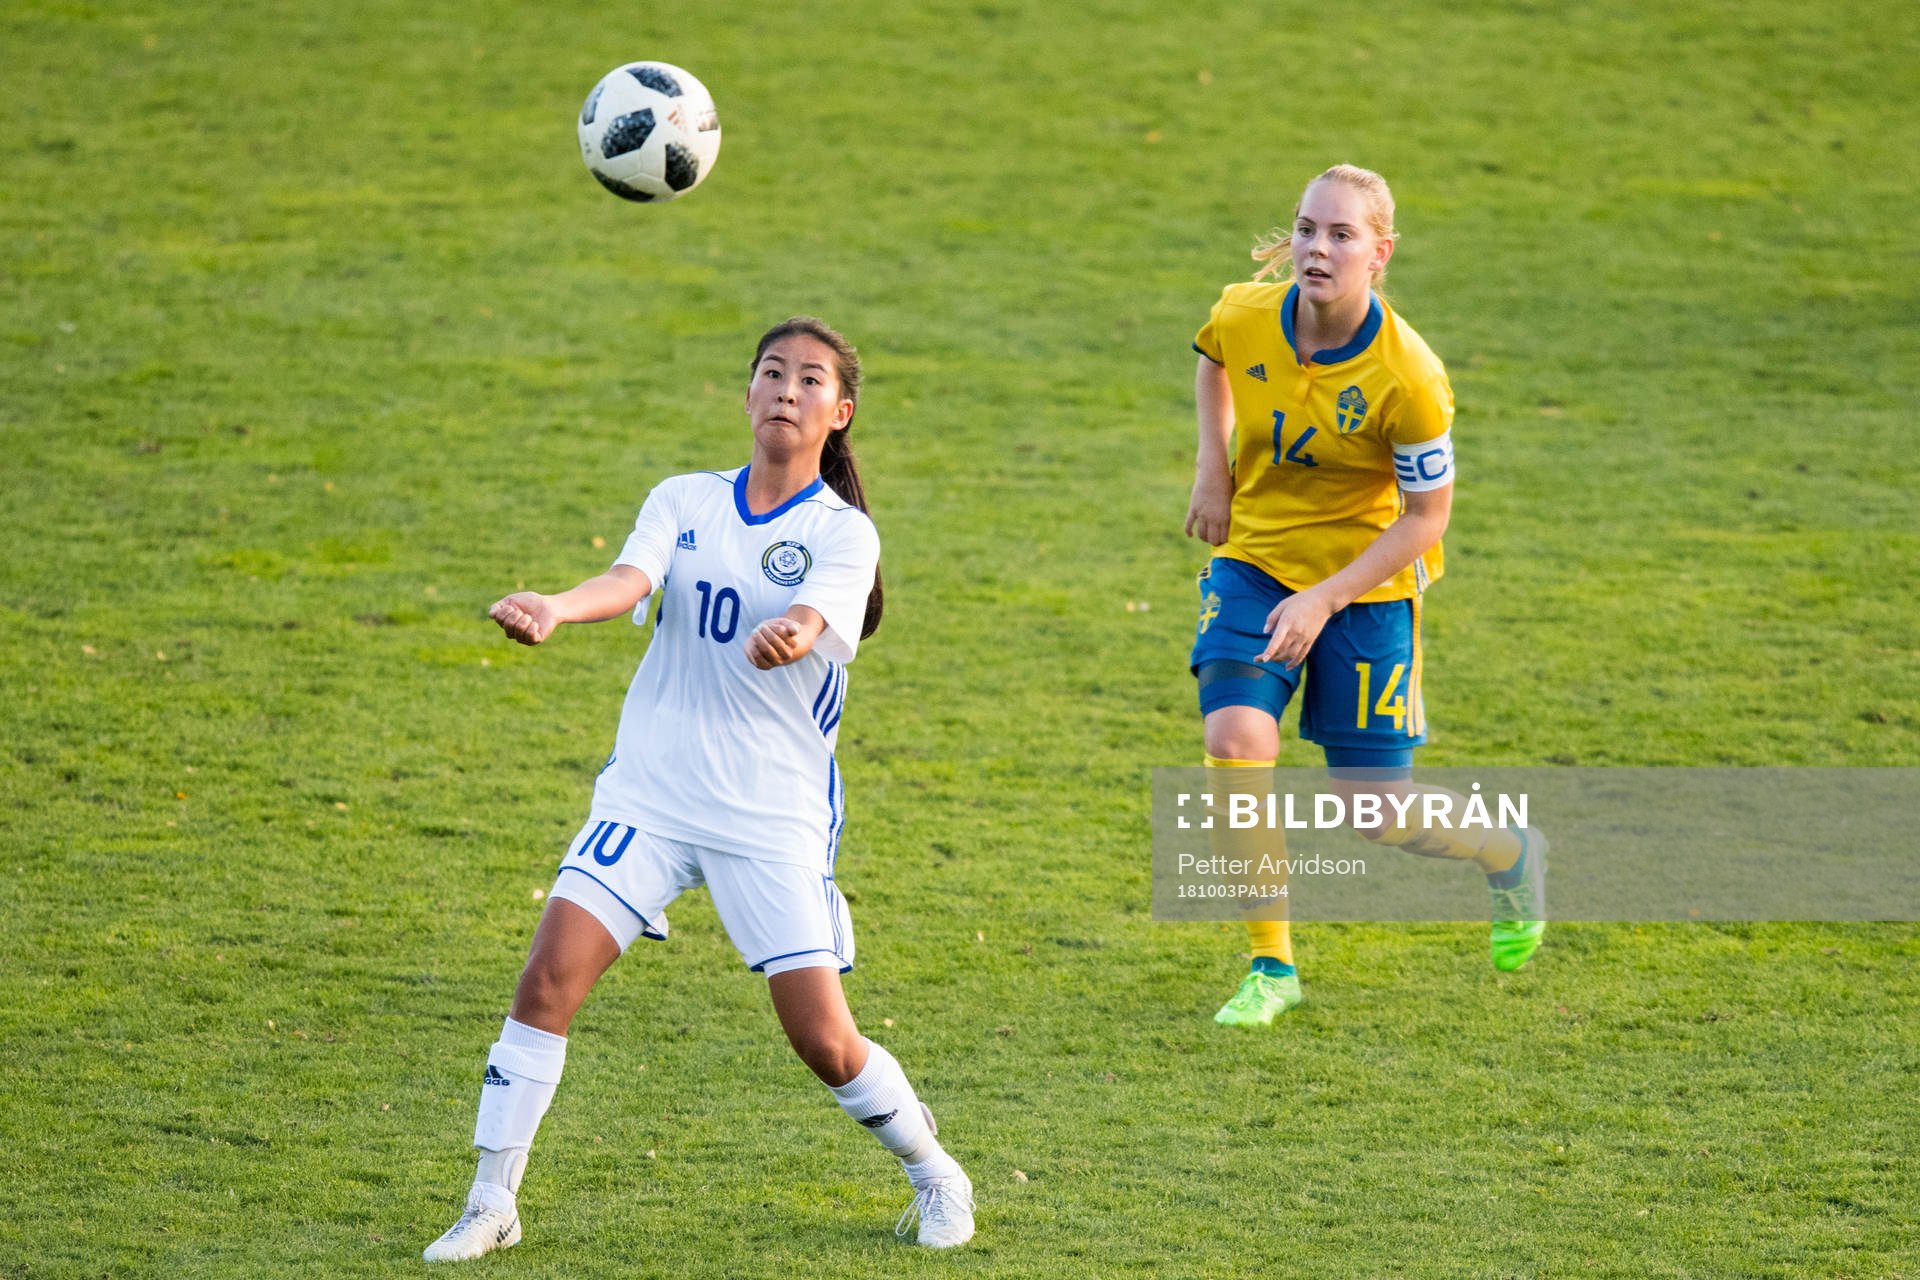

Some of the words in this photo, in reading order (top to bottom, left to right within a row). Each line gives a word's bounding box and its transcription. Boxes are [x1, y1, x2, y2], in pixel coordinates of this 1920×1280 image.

[1272, 409, 1319, 467] 14
[696, 580, 740, 643] 10
[1355, 662, 1406, 730] 14
[577, 821, 637, 866] 10
